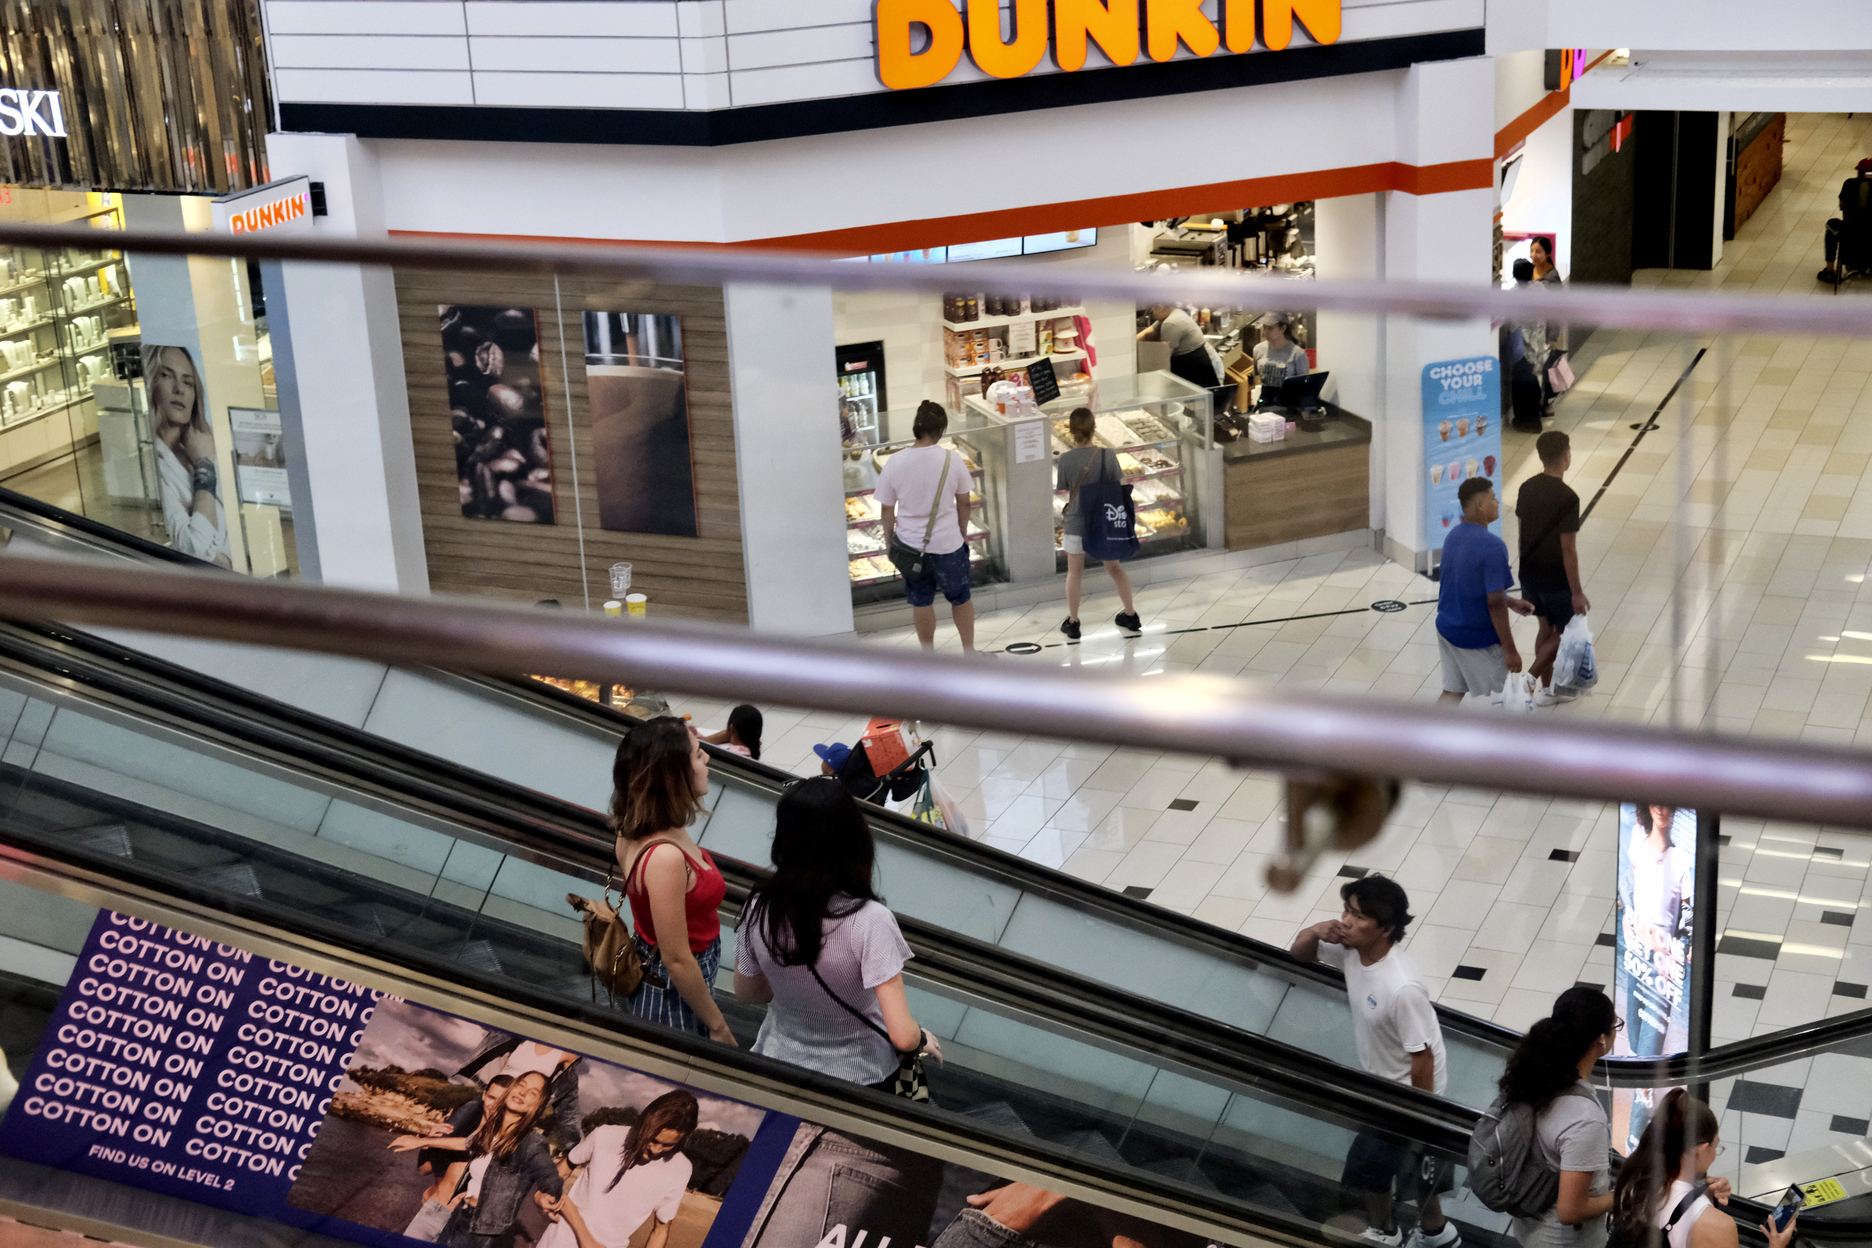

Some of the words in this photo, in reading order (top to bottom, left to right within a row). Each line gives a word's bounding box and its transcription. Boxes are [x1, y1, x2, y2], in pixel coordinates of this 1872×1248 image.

[0, 88, 67, 137] SKI
[1430, 360, 1493, 379] CHOOSE
[1441, 374, 1483, 390] YOUR
[99, 930, 204, 974] COTTON
[206, 962, 245, 986] ON
[1624, 929, 1653, 960] GET
[1654, 951, 1684, 985] ONE
[1655, 928, 1685, 962] ONE
[88, 954, 194, 997] COTTON
[196, 985, 235, 1009] ON
[258, 977, 358, 1019] COTTON
[1623, 950, 1654, 986] 50%
[1655, 976, 1683, 1006] OFF
[68, 1000, 173, 1043] COTTON
[175, 1031, 214, 1056] ON
[78, 977, 184, 1020] COTTON
[186, 1008, 224, 1032] ON
[248, 1000, 347, 1042] COTTON
[57, 1024, 162, 1067] COTTON
[165, 1054, 204, 1078] ON
[227, 1046, 326, 1087] COTTON
[237, 1024, 337, 1064] COTTON
[46, 1049, 151, 1091] COTTON
[154, 1078, 193, 1102] ON
[217, 1069, 315, 1110] COTTON
[24, 1097, 130, 1137] COTTON
[133, 1124, 172, 1147] ON
[35, 1073, 140, 1114] COTTON
[144, 1102, 182, 1126] ON
[206, 1092, 305, 1132] COTTON
[185, 1138, 285, 1177] COTTON
[195, 1116, 295, 1155] COTTON
[88, 1144, 126, 1164] FIND
[128, 1154, 149, 1169] US
[151, 1160, 176, 1176] ON
[178, 1166, 222, 1188] LEVEL
[223, 1179, 236, 1191] 2
